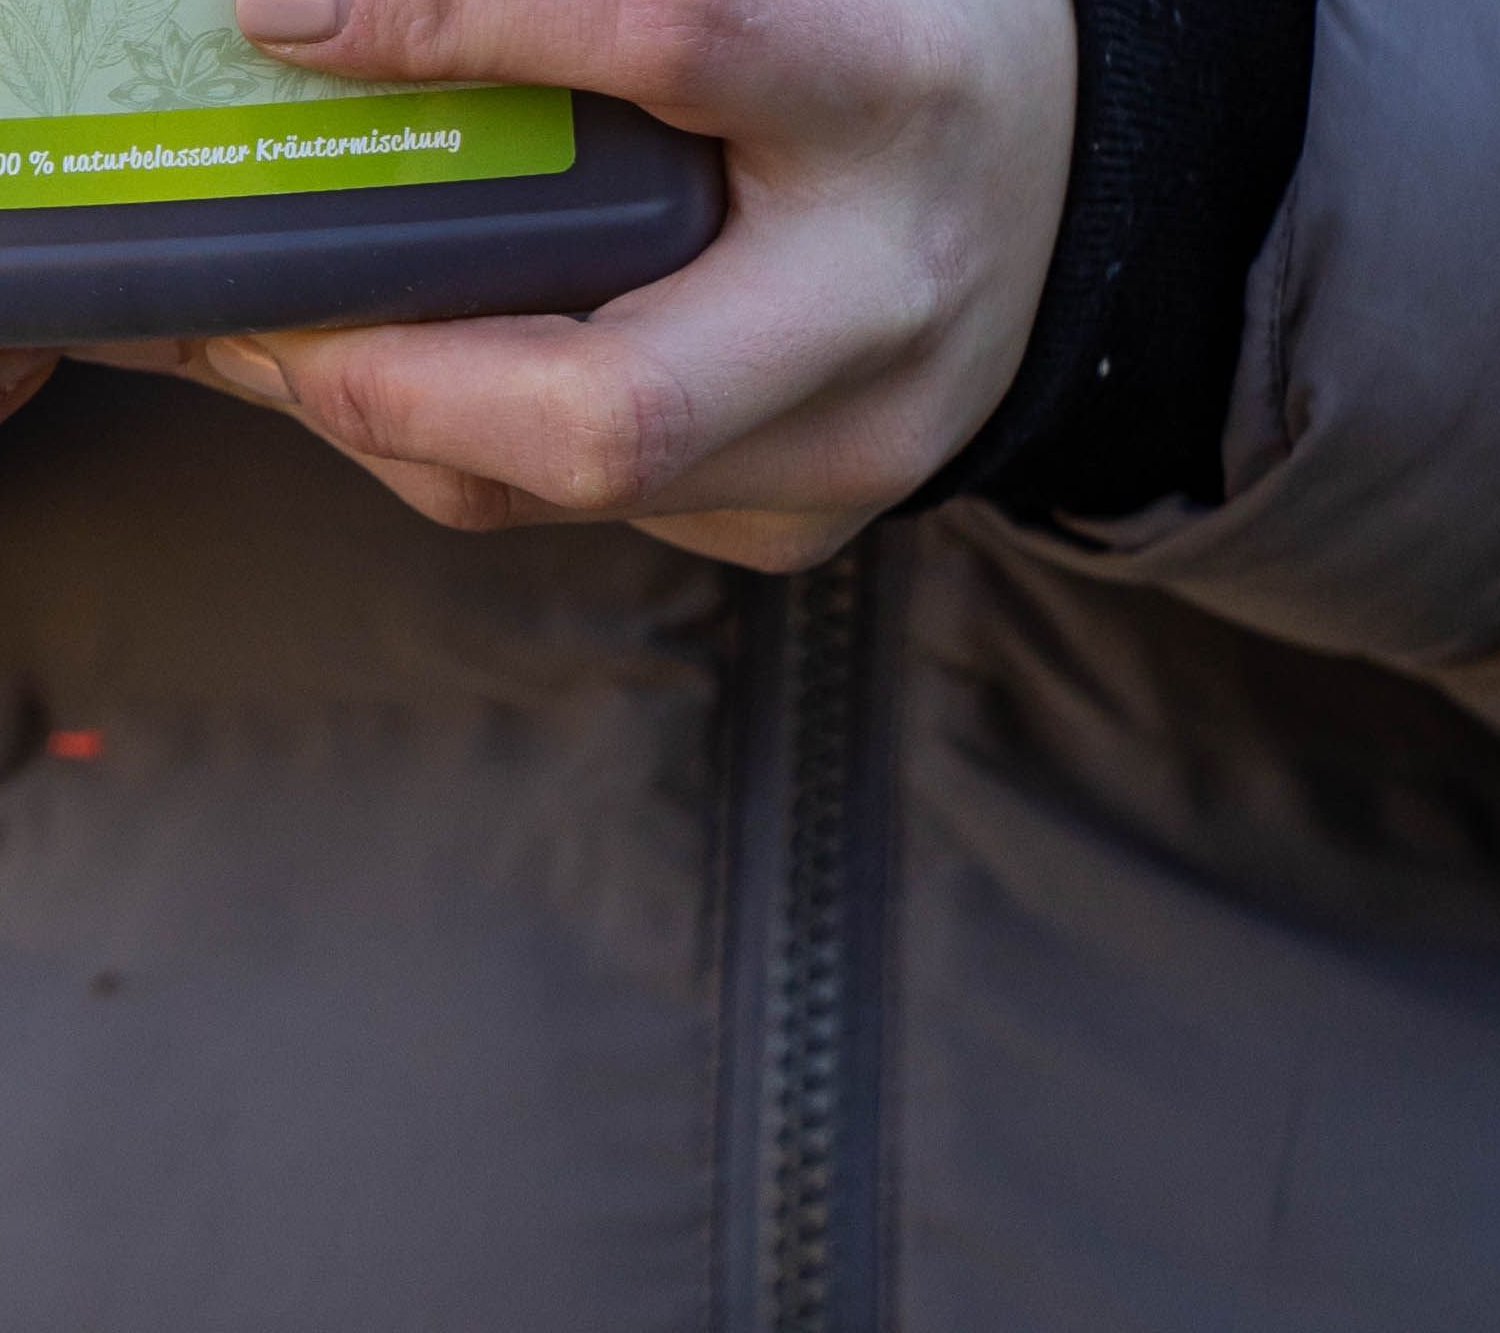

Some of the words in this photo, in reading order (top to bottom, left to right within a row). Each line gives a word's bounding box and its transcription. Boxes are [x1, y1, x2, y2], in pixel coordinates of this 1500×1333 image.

[25, 149, 56, 178] %
[62, 143, 250, 173] naturbelassener
[255, 128, 462, 163] Kräutermischung
